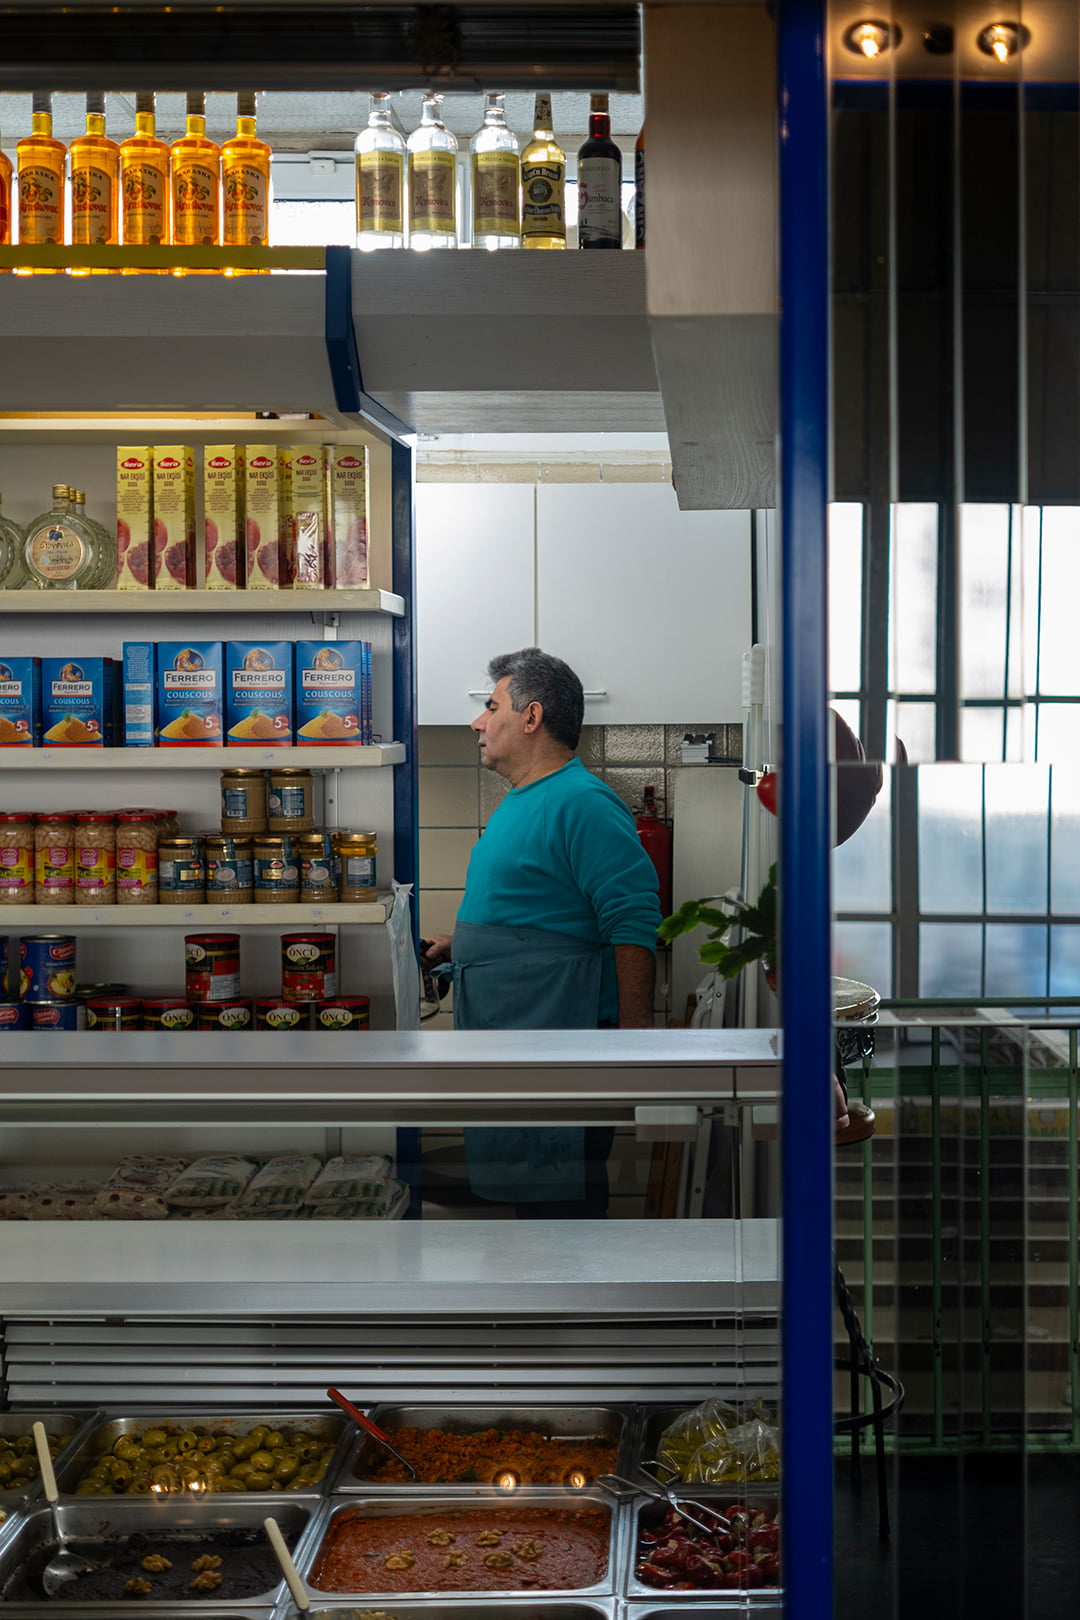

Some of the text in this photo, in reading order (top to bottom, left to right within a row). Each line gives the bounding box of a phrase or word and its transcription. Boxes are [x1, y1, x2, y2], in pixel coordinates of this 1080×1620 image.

[165, 673, 213, 682] FERRERO
[234, 672, 283, 682] FERRERO
[304, 672, 353, 682] FERRERO
[53, 682, 91, 691] FERRERO
[166, 691, 213, 699] COUSCOUS
[235, 690, 283, 698] COUSCOUS
[305, 689, 352, 698] COUSCOUS
[15, 721, 23, 732] 5
[86, 721, 94, 732] 5
[205, 716, 213, 729] 5
[274, 716, 282, 729] 5
[343, 715, 352, 728] 5
